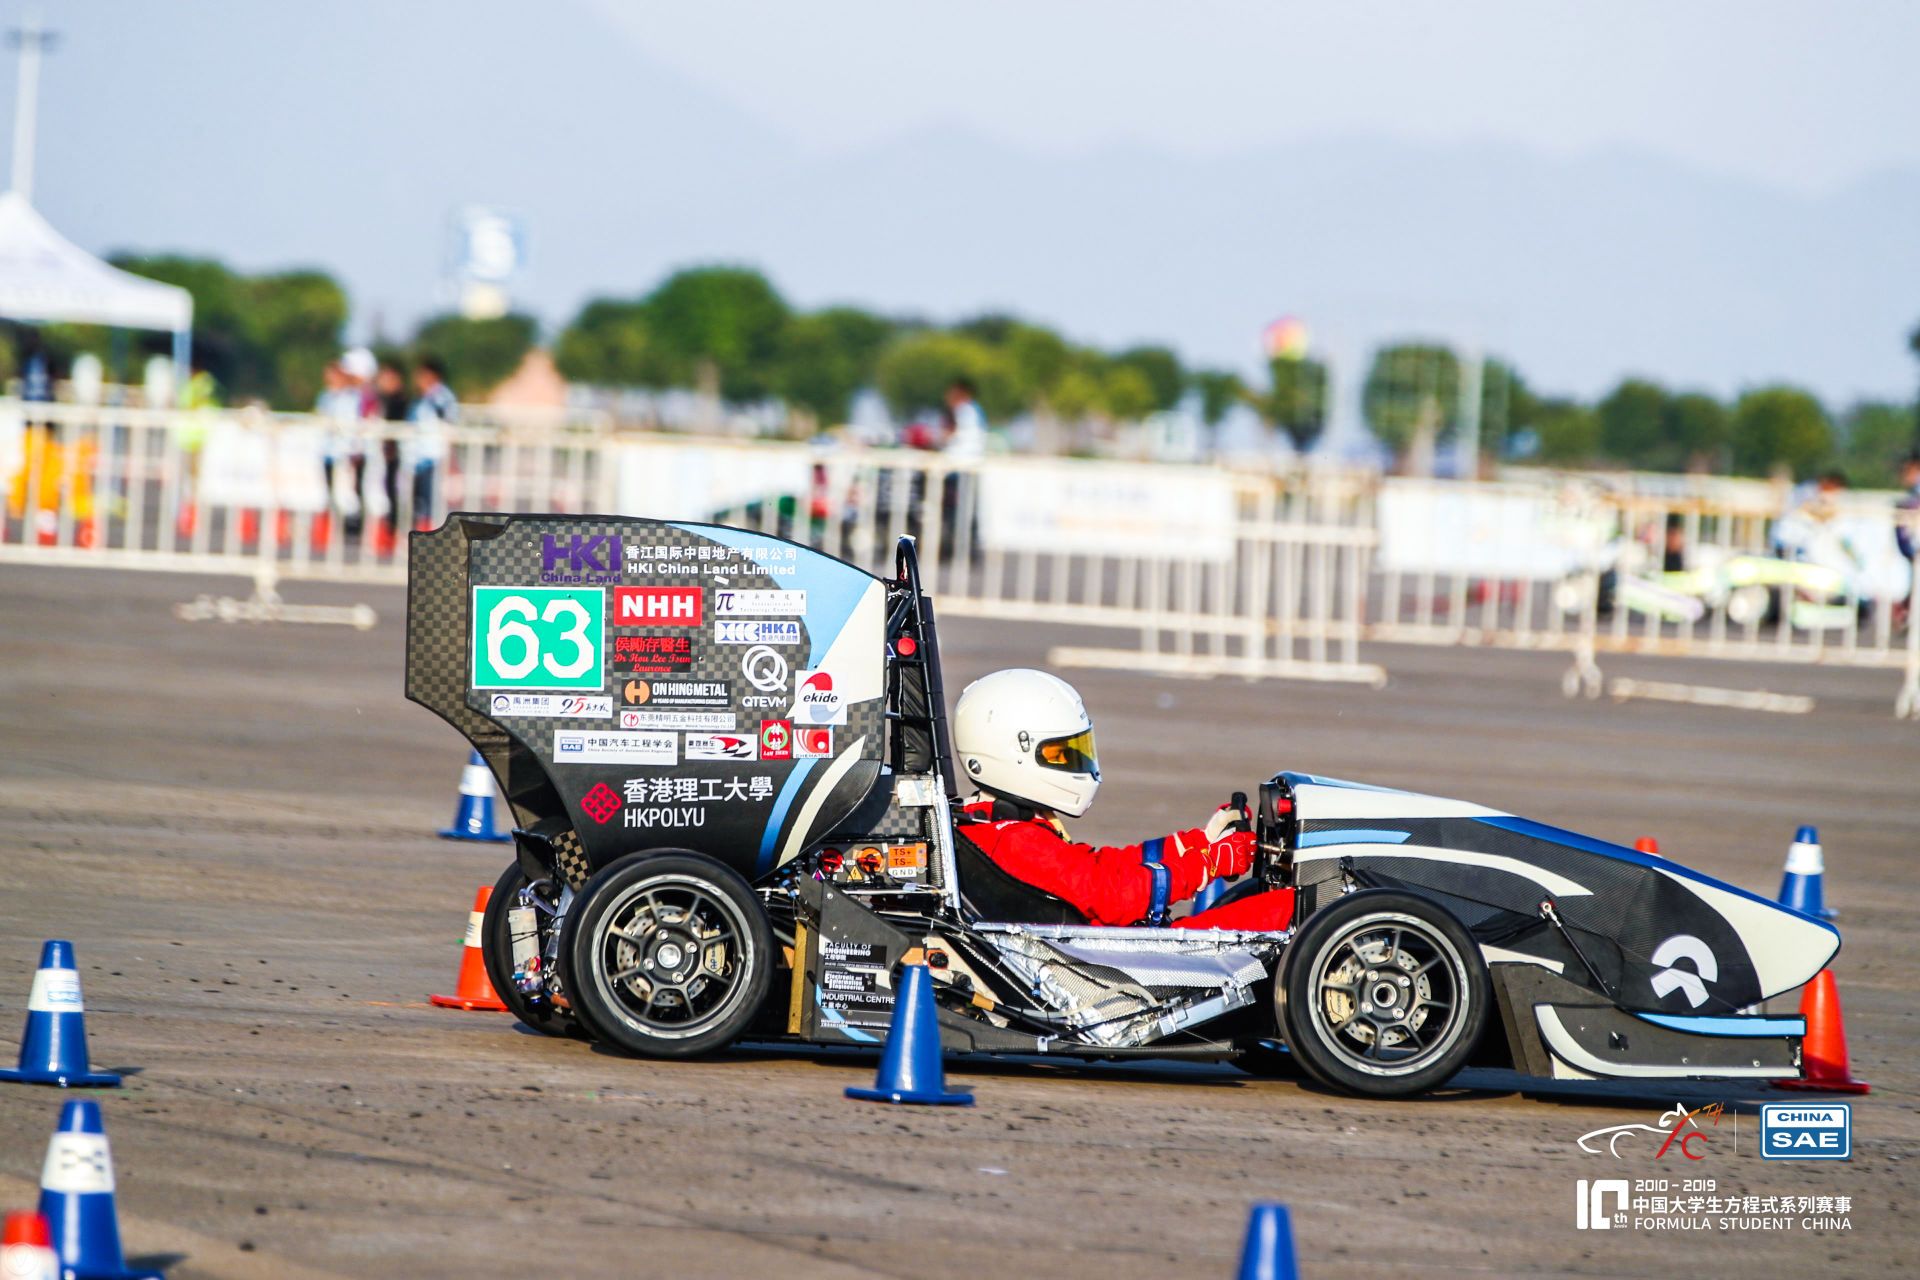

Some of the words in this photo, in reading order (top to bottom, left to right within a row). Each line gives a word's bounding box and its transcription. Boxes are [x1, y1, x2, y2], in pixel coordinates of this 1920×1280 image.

[543, 534, 622, 571] HKI
[626, 545, 797, 561] 香江国际中国地产有限公司
[627, 563, 652, 574] HKI
[657, 563, 698, 574] China
[703, 563, 738, 575] Land
[743, 563, 796, 575] Limited
[541, 572, 581, 582] China
[586, 572, 621, 583] Land
[622, 594, 694, 618] NHH
[761, 623, 797, 634] HKA
[487, 595, 594, 680] 63
[652, 682, 667, 696] ON
[668, 682, 694, 697] HING
[694, 683, 728, 697] METAL
[742, 695, 787, 708] QTEVM
[803, 692, 838, 703] ekide
[587, 737, 673, 748] 中国汽车工程学会
[623, 776, 773, 804] 香港理工大學
[624, 807, 705, 828] HKPOLYU
[892, 868, 914, 876] GND
[825, 948, 872, 957] ENGINEERING
[821, 993, 865, 1003] INDUSTRIAL
[865, 995, 896, 1004] CENTRE
